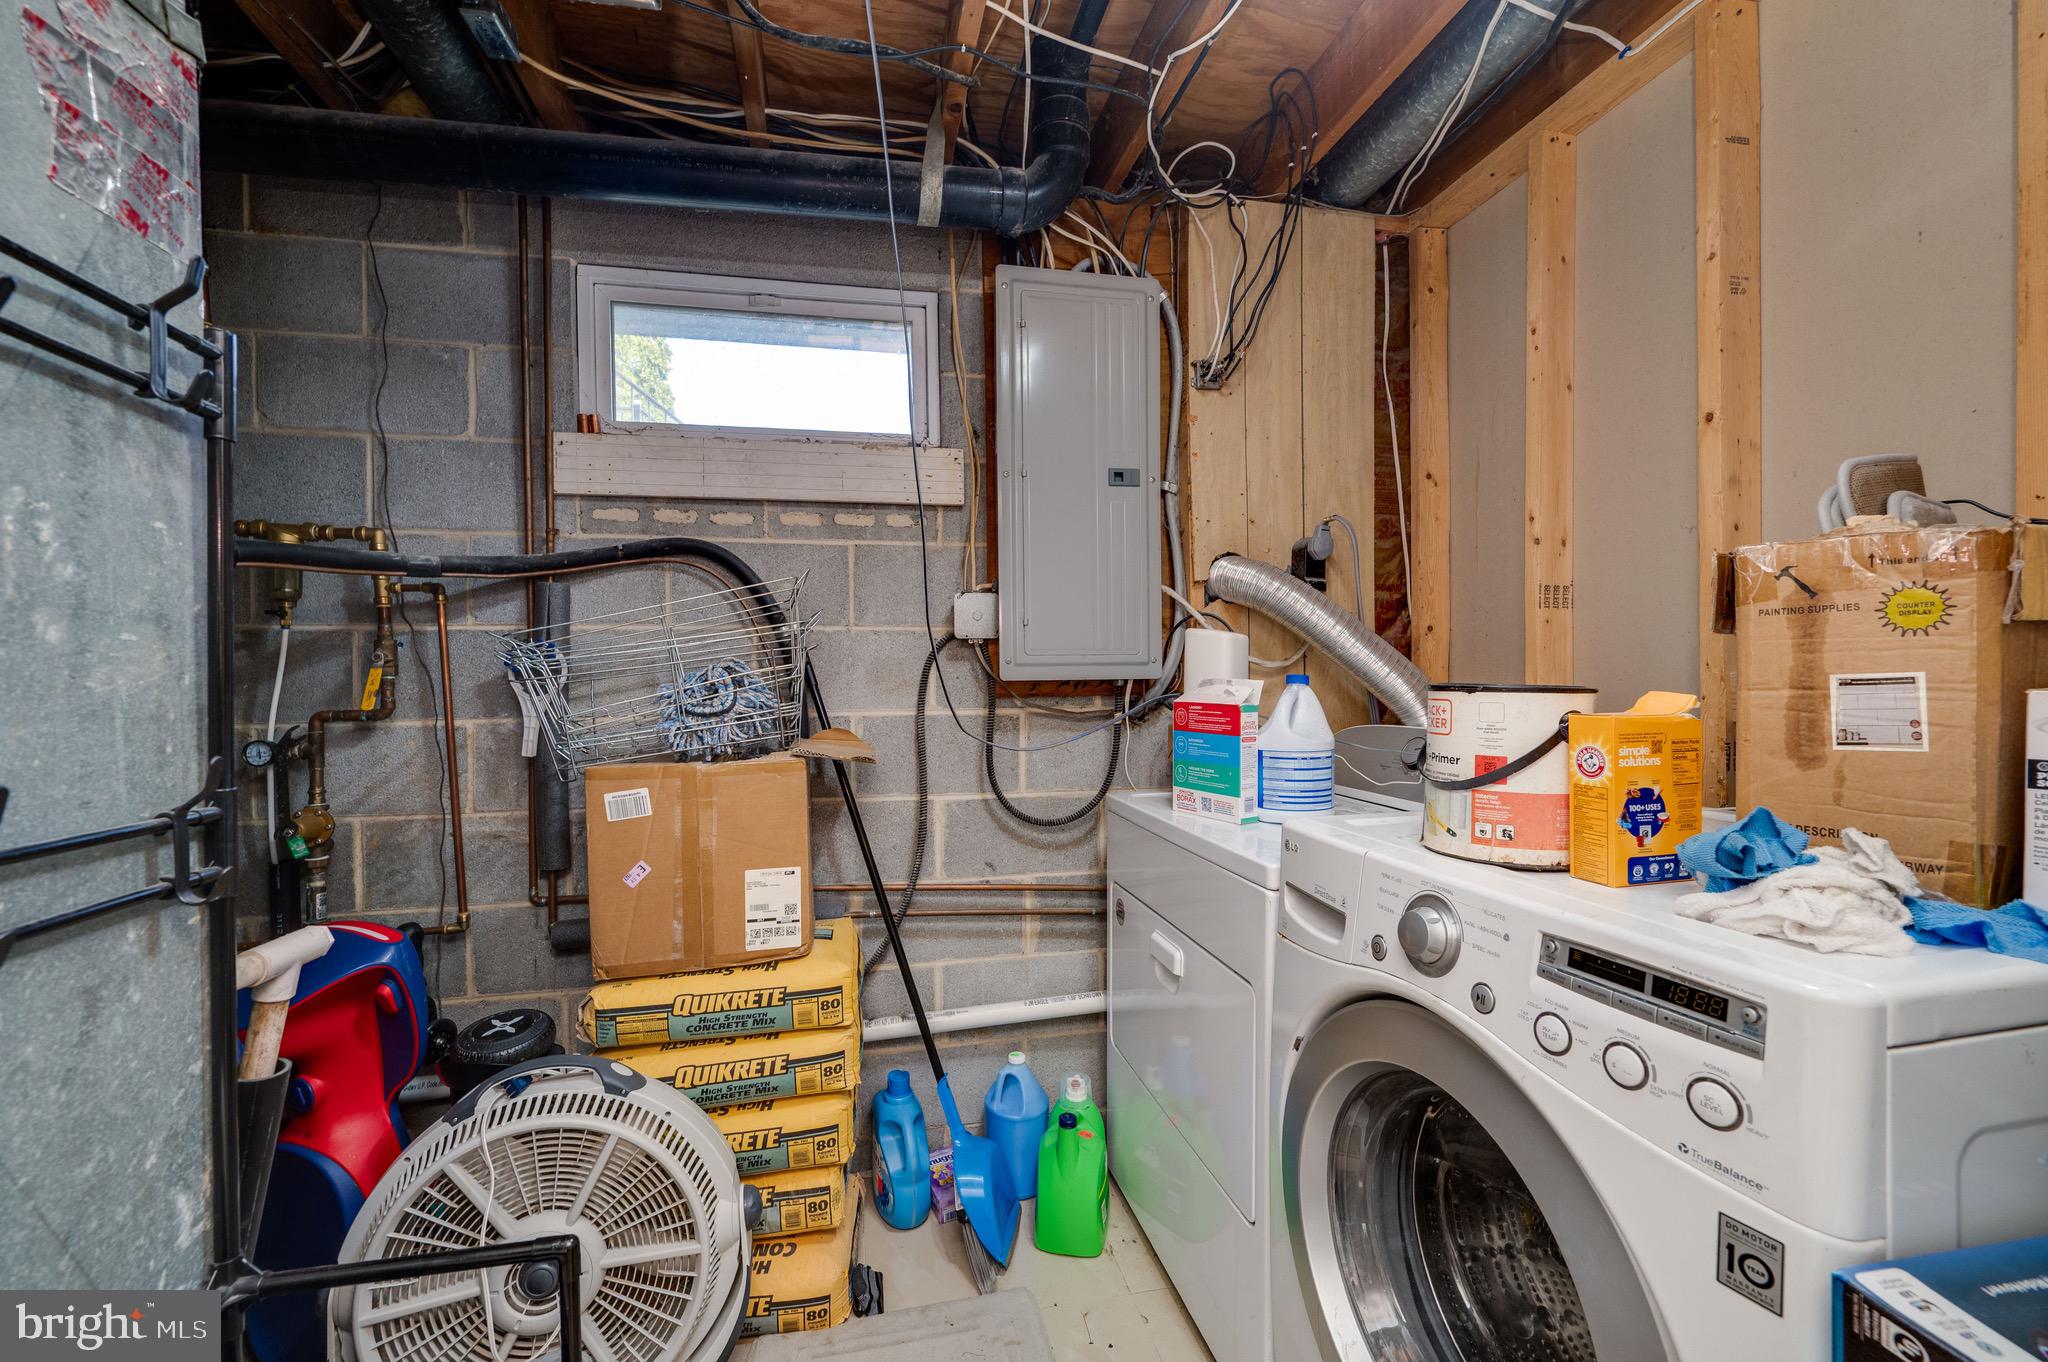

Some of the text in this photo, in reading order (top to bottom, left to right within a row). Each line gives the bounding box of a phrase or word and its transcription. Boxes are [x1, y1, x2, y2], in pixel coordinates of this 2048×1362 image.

[1758, 602, 1861, 618] PAINTING SUPPLIES
[1896, 600, 1936, 609] COUNTER
[1898, 608, 1932, 617] DISPLAY
[1618, 745, 1650, 757] simple
[1618, 755, 1662, 768] solutions
[1176, 794, 1196, 804] BORAX
[1628, 803, 1662, 812] 100+ USES
[672, 986, 788, 1018] QUIKRETE
[820, 998, 841, 1011] 80
[685, 1017, 777, 1033] CONCRETE MIX
[698, 1012, 769, 1025] HIGH STRENGTH
[674, 1053, 790, 1090] QUIKRETE
[823, 1063, 843, 1078] 80
[700, 1081, 771, 1096] HIGH STRENGTH
[754, 1085, 780, 1095] MIX
[736, 1099, 775, 1112] HIGH
[1699, 1099, 1725, 1116] LEVEL
[816, 1137, 837, 1152] 80
[747, 1159, 773, 1168] MIX
[1691, 1148, 1764, 1192] TrueBalance
[807, 1199, 829, 1214] 80
[1725, 1221, 1778, 1253] DD MOTOR
[1725, 1241, 1776, 1291] 10
[1746, 1263, 1766, 1279] YEAR
[806, 1308, 828, 1322] 80
